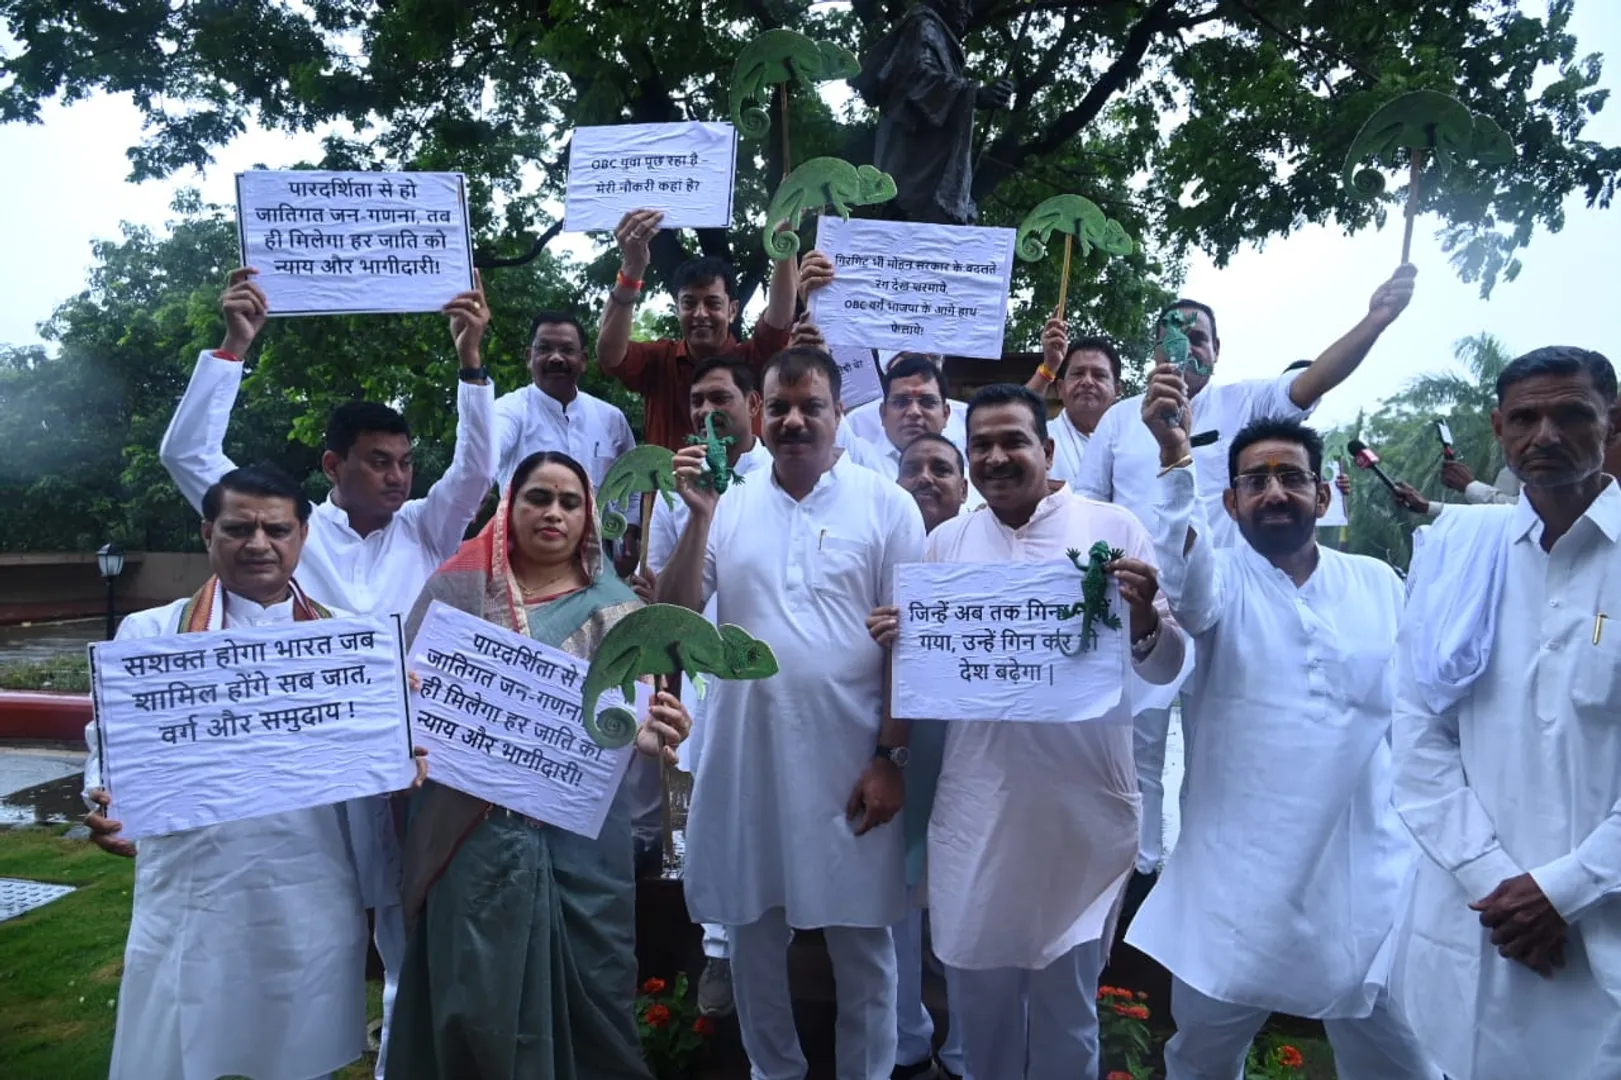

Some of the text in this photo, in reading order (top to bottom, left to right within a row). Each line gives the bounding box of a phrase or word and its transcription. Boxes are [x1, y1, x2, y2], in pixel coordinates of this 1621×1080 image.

[591, 159, 617, 170] OBC
[621, 157, 641, 170] युवा
[645, 155, 664, 169] पूछ
[667, 155, 687, 167] रहा
[689, 151, 699, 167] है
[288, 177, 417, 199] पारदर्शिता से हो
[595, 180, 616, 194] मेरी
[620, 178, 655, 193] नौकरी
[256, 203, 324, 223] जातिगत
[425, 209, 451, 223] तब
[264, 228, 447, 250] ही मिलेगा हर जाति को
[274, 254, 440, 276] न्याय और भागीदारी!
[872, 255, 884, 269] भी
[887, 256, 913, 270] मोहन
[916, 260, 950, 272] सरकार
[952, 259, 963, 272] के
[891, 278, 909, 291] देख
[844, 298, 977, 317] OBC वर्ग भाजपा के आगे हाथ
[909, 600, 949, 623] जिन्हें
[954, 605, 983, 622] अब
[989, 605, 1021, 621] तक
[1026, 599, 1070, 620] गिन
[919, 635, 956, 653] गया,
[962, 629, 996, 652] उन्हें
[1002, 629, 1036, 651] गिन
[1042, 634, 1071, 651] कर
[122, 631, 375, 678] सशक्त होगा भारत जब
[473, 633, 558, 679] पारदर्शिता
[561, 664, 579, 688] से
[427, 649, 497, 689] जातिगत
[959, 658, 990, 682] देश
[995, 658, 1042, 684] बढ़ेगा
[132, 665, 372, 712] शामिल होंगे सब जात,
[159, 714, 199, 744] वर्ग
[207, 710, 253, 738] और
[259, 701, 341, 732] समुदाय
[420, 677, 442, 700] ही
[444, 683, 501, 723] मिलेगा
[505, 710, 530, 734] हर
[535, 724, 576, 750] जाति
[417, 710, 583, 787] न्याय और भागीदारी!
